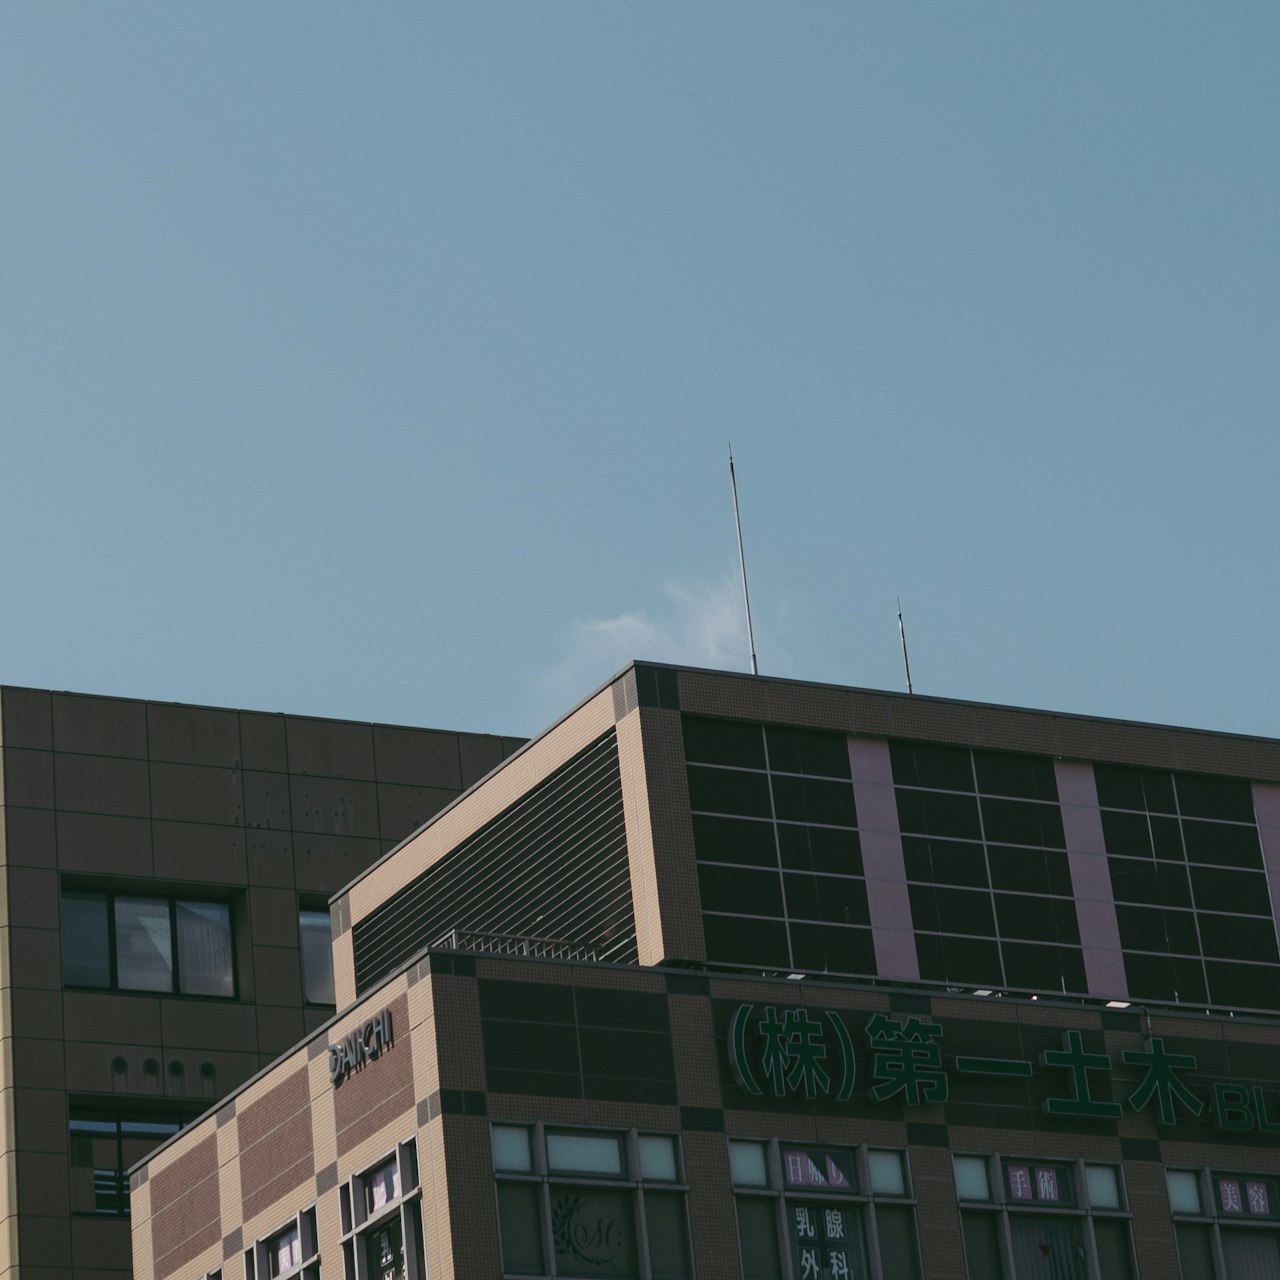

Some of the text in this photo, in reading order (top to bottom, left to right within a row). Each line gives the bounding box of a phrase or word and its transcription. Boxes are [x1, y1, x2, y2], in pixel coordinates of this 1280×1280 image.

[1011, 1169, 1055, 1199] 手術
[1222, 1182, 1265, 1213] 美容
[795, 1207, 845, 1239] 乳腺
[800, 1248, 849, 1280] 外科
